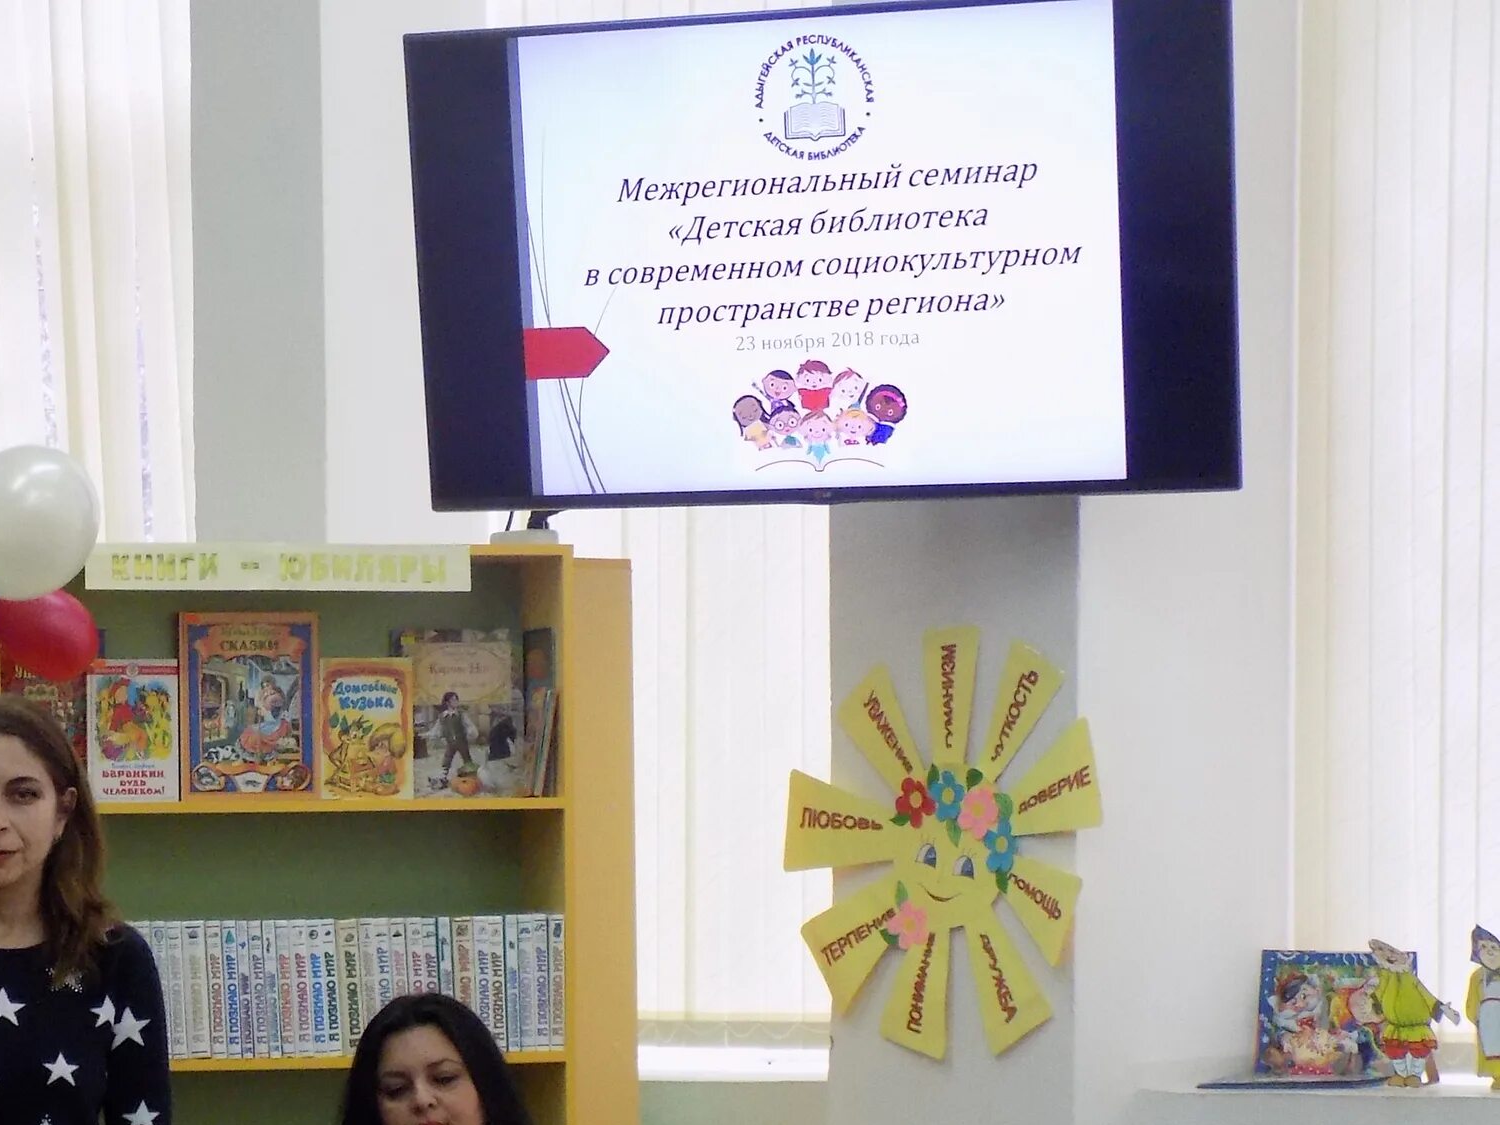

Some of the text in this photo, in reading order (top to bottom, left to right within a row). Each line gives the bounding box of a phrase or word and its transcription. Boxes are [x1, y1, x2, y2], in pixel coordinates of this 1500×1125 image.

[755, 34, 875, 109] АДЫГЕЙСКАЯ РЕСПУБЛИКАНСКАЯ
[763, 126, 866, 161] ДЕТСКАЯ БИБЛИОТЕКА
[617, 162, 1038, 206] Межрегиональный семинар
[668, 207, 988, 246] «Детская библиотека
[584, 246, 1082, 291] в современном социокультурном
[657, 292, 1006, 331] пространстве региона»
[735, 331, 921, 353] 23 ноября 2018 года
[111, 553, 218, 581] КНИГИ
[280, 553, 446, 583] ЮБИЛЯРЫ
[940, 644, 957, 749] ГУМАНИЗМ
[991, 670, 1040, 762] ЧУТКОСТЬ
[864, 690, 914, 773] УВАЖЕНИЕ
[1018, 765, 1092, 815] ДОВЕРИЕ
[800, 807, 884, 831] ЛЮБОВЬ
[1007, 873, 1062, 921] ПОМОЩЬ
[535, 947, 546, 972] МИР
[820, 907, 898, 967] ТЕРПЕНИЕ
[225, 954, 236, 980] МИР
[295, 952, 307, 979] МИР
[310, 952, 321, 979] МИР
[325, 951, 336, 977] МИР
[478, 950, 489, 975] МИР
[491, 952, 503, 977] МИР
[906, 932, 936, 1034] ПОНИМАНИЕ
[227, 983, 239, 1033] ПОЗНАЮ
[297, 981, 310, 1030] ПОЗНАЮ
[313, 982, 325, 1032] ПОЗНАЮ
[327, 980, 339, 1029] ПОЗНАЮ
[492, 980, 505, 1029] ПОЗНАЮ
[536, 976, 548, 1024] ПОЗНАЮ
